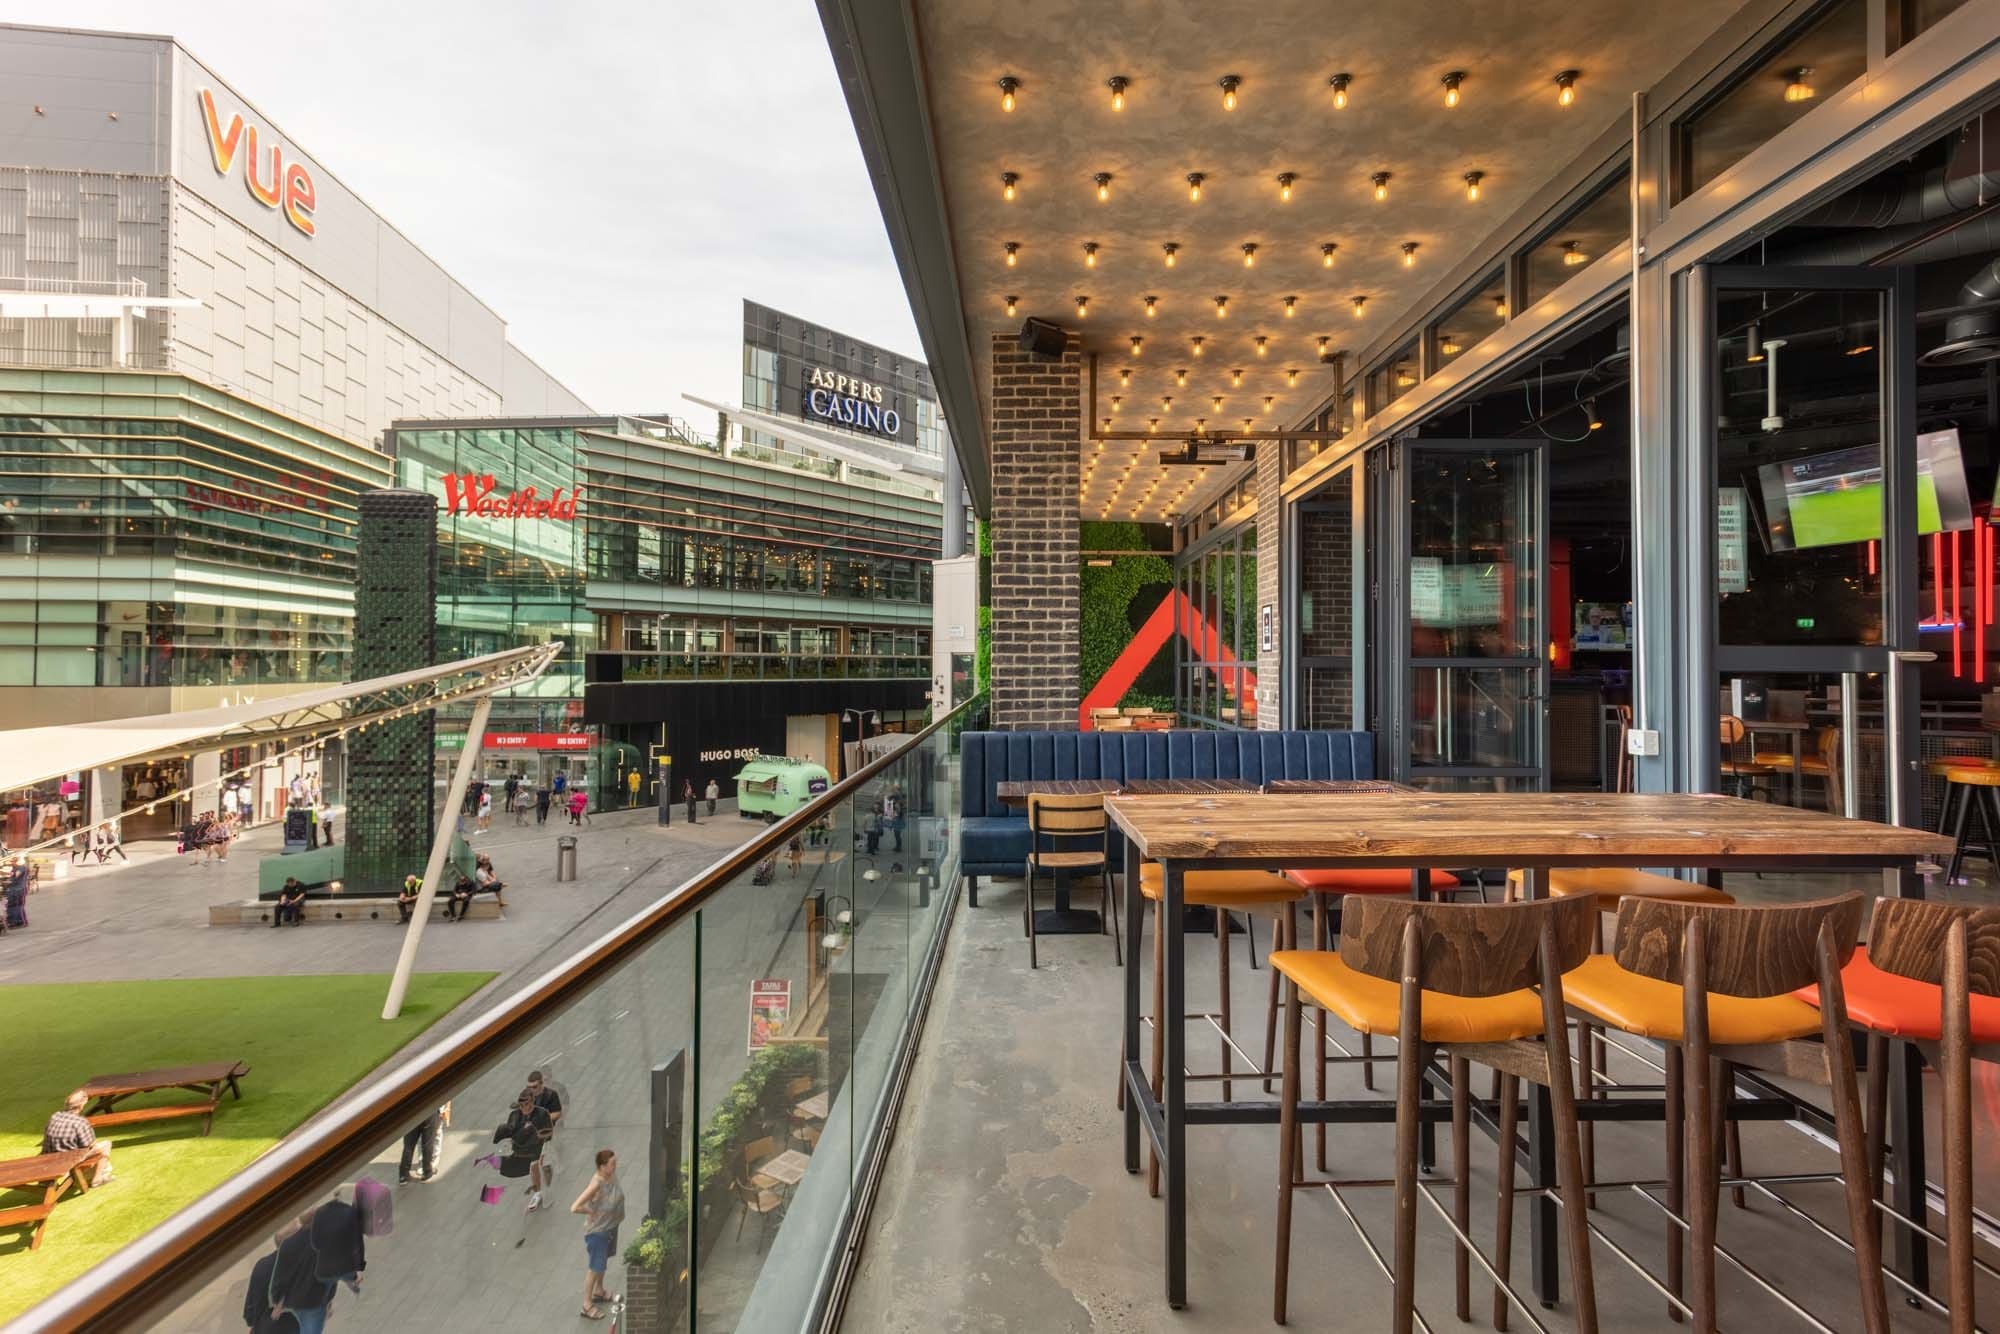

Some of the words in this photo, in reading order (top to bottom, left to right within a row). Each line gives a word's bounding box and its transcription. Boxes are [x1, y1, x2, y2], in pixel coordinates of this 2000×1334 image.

[809, 367, 882, 403] ASPERS
[808, 388, 900, 435] CASINO
[440, 471, 585, 521] Westfield
[507, 737, 527, 745] ENTRY
[567, 737, 588, 745] ENTRY
[700, 750, 732, 762] HUGO
[734, 747, 760, 760] BOSS
